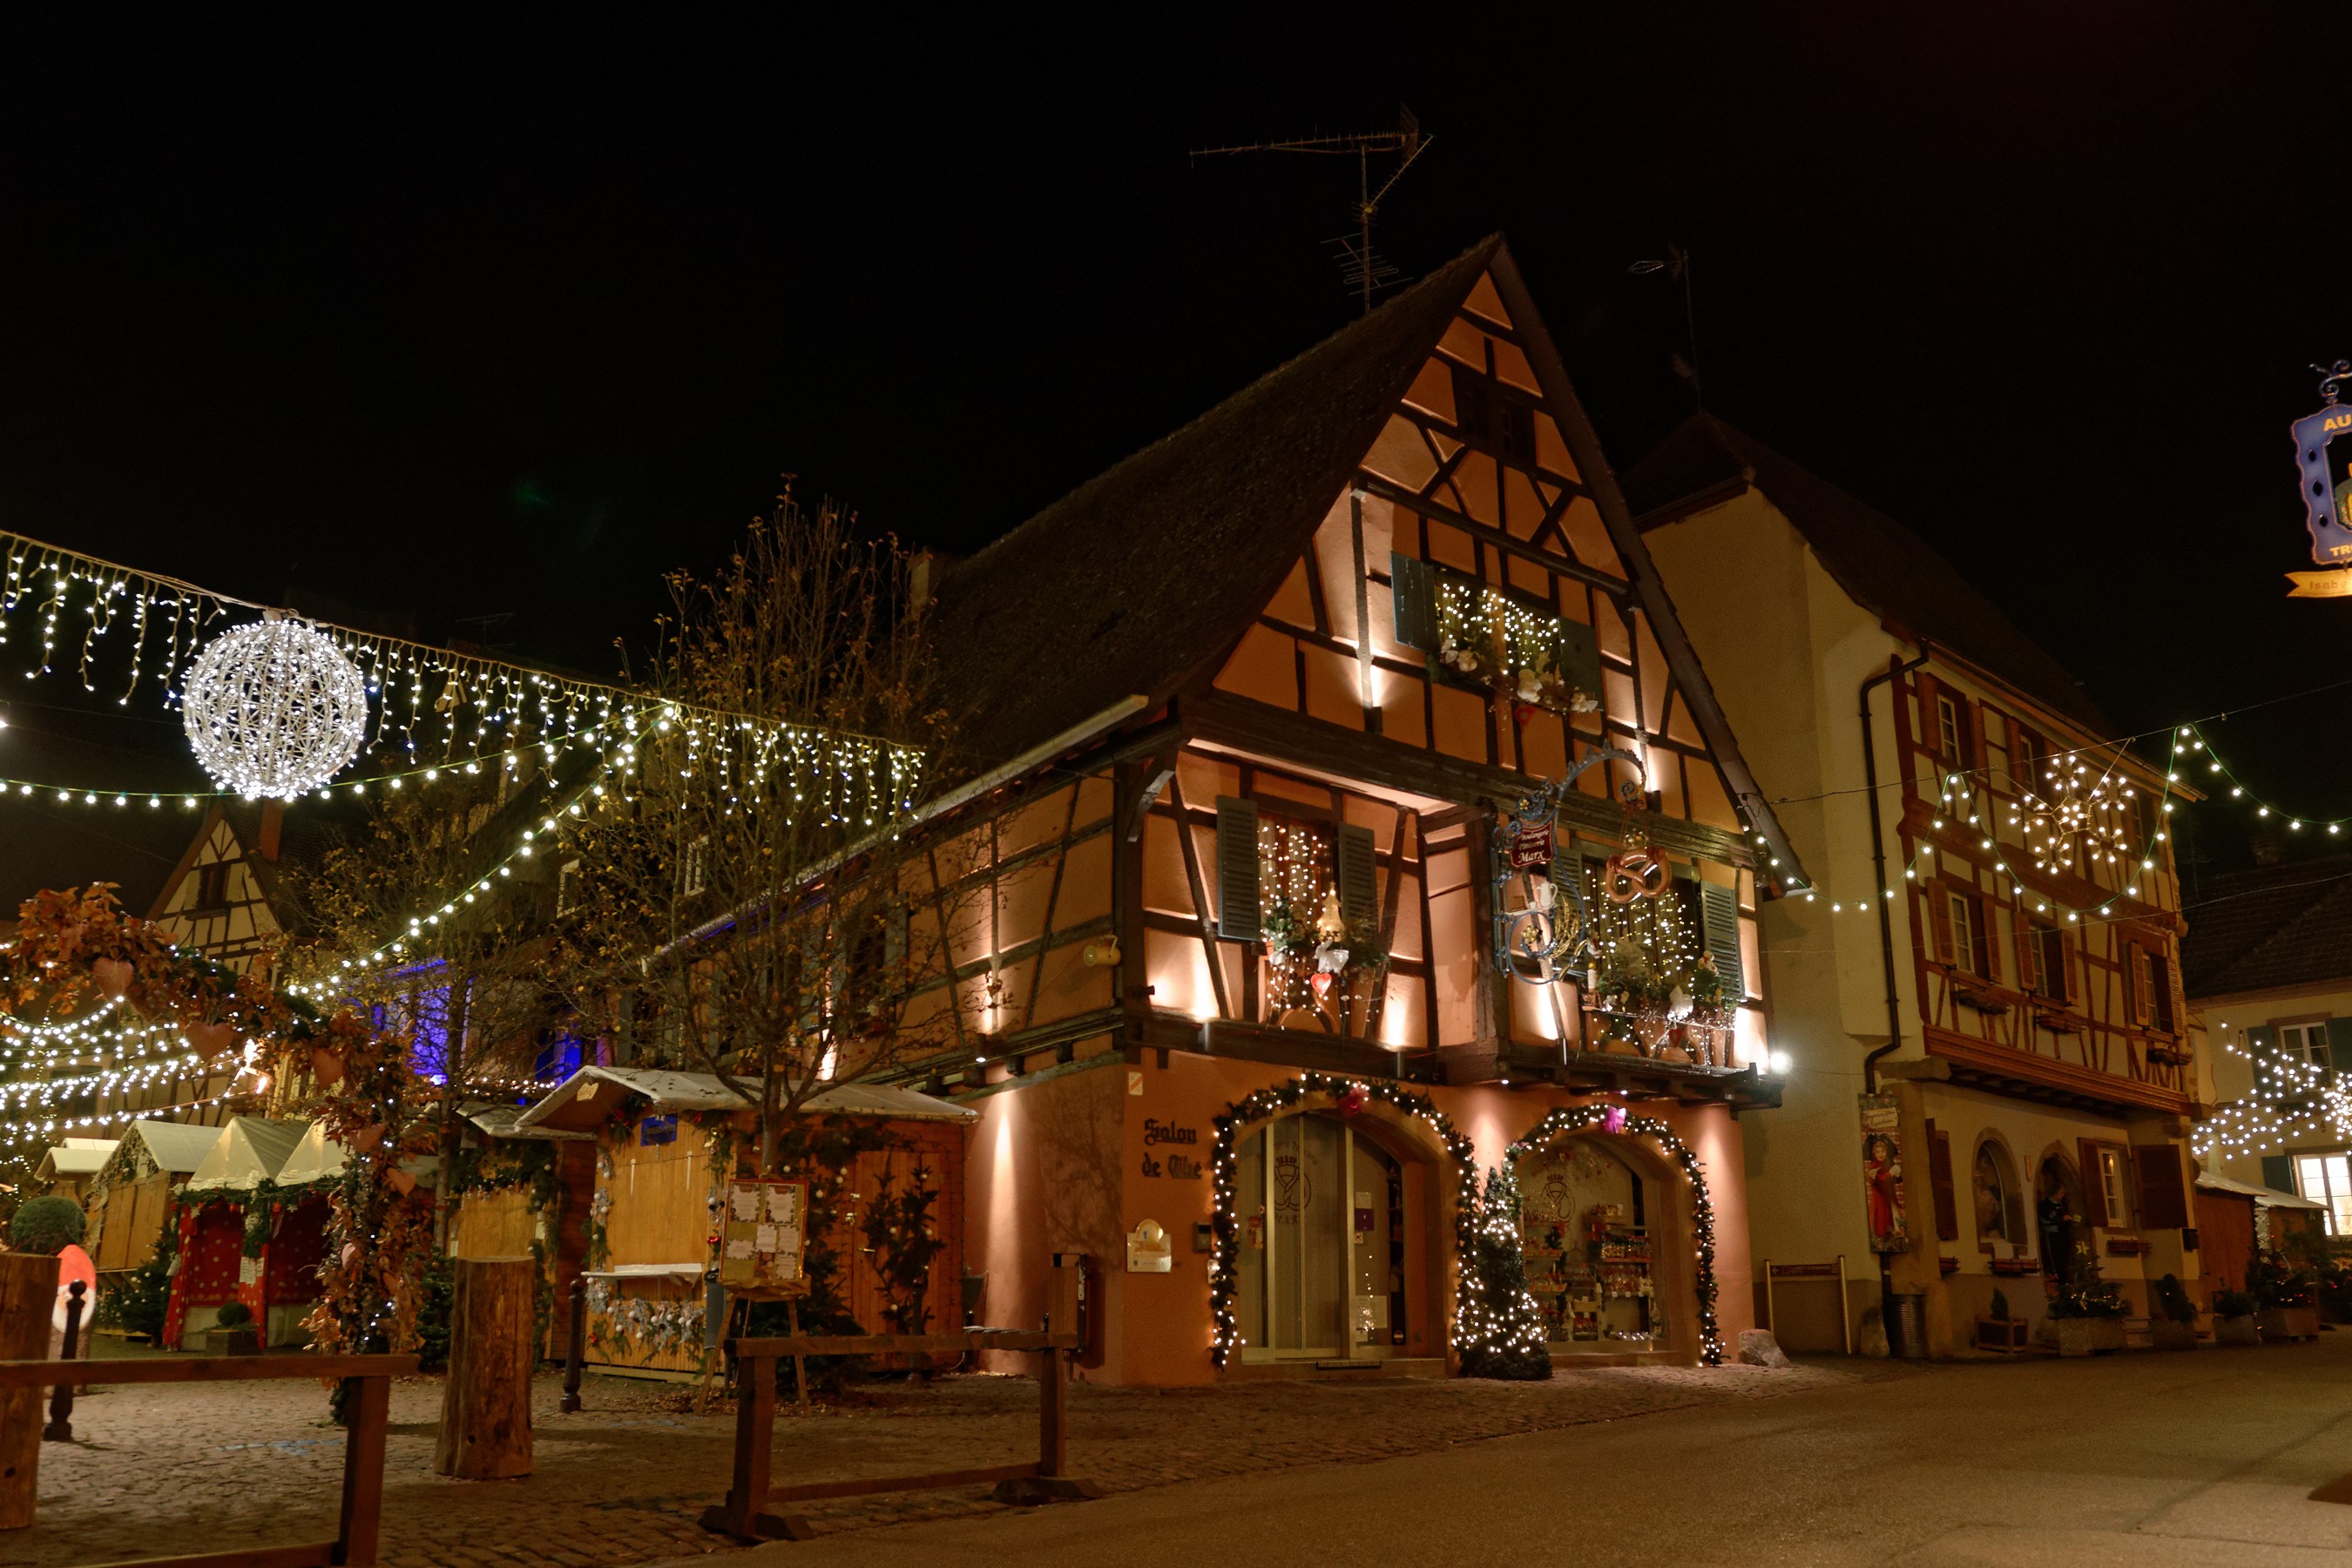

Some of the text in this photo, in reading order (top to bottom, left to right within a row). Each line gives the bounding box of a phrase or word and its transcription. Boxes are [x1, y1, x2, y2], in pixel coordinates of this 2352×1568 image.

[2329, 544, 2352, 557] TR
[2309, 579, 2350, 590] Isabe
[1518, 850, 1546, 863] Marx
[1144, 1118, 1198, 1146] Salon
[1142, 1151, 1162, 1178] de
